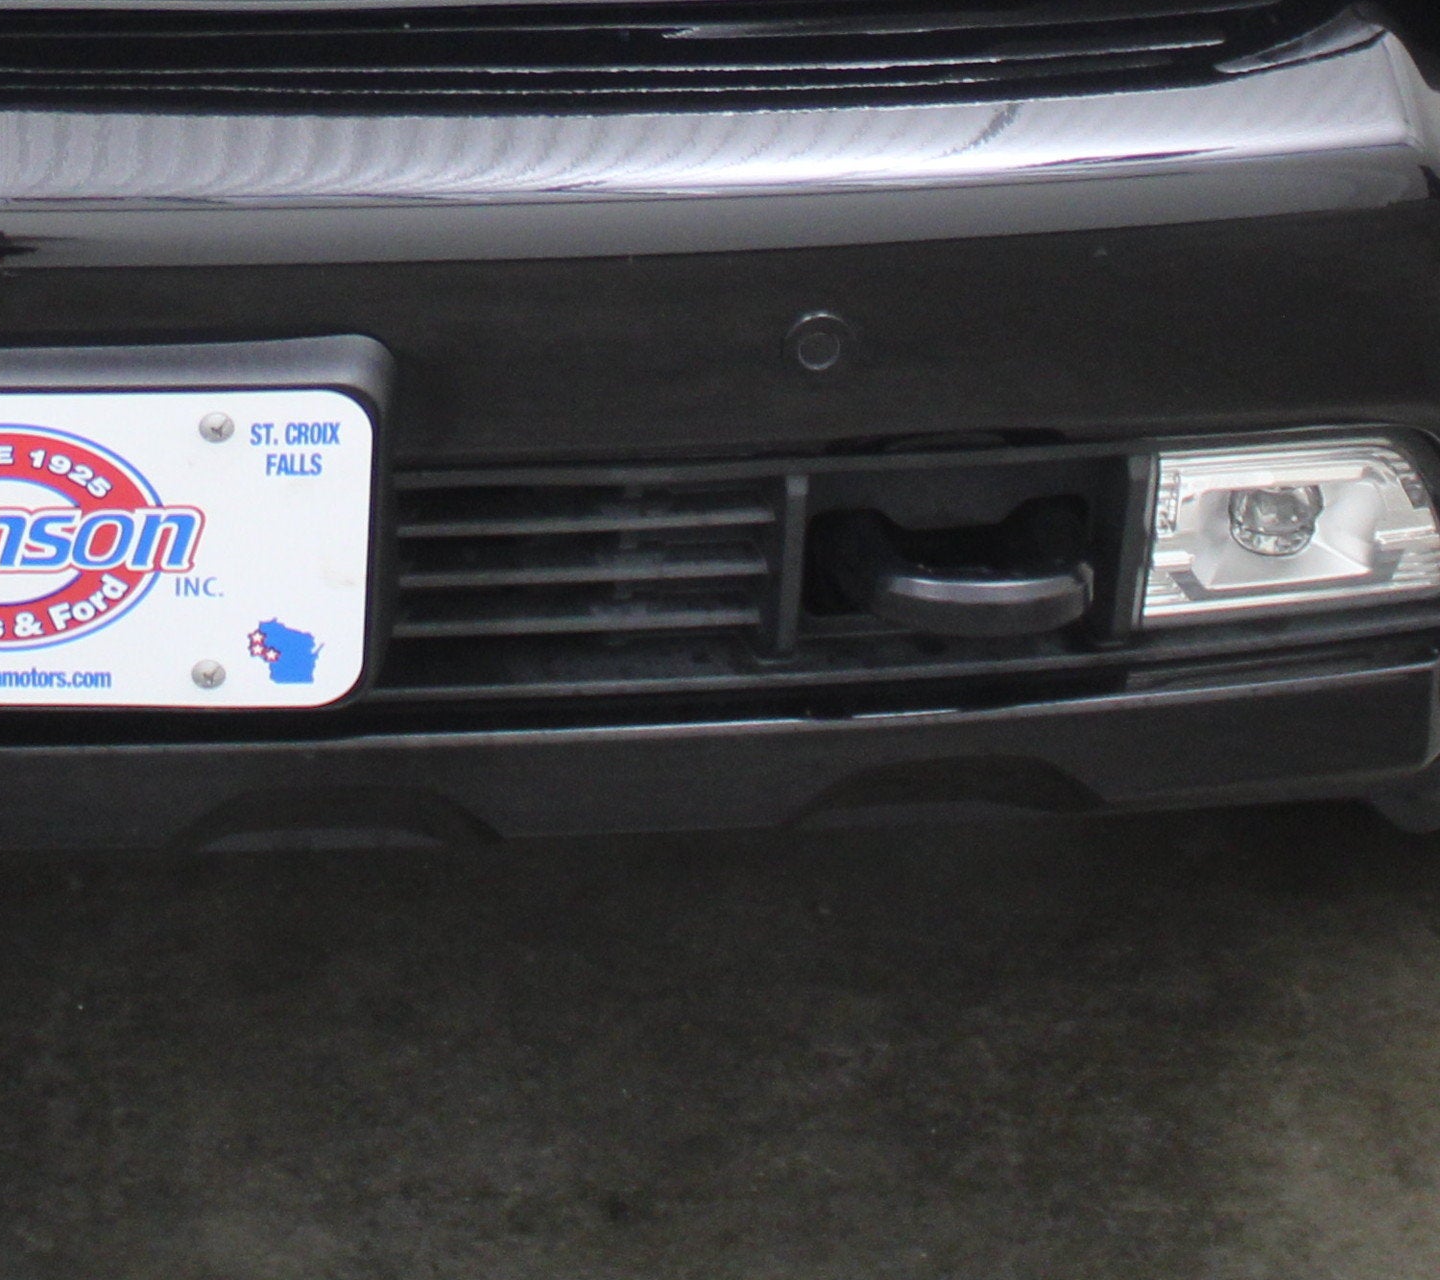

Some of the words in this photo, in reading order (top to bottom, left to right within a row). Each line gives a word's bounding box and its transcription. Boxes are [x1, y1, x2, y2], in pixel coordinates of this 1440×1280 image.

[250, 423, 278, 447] ST.
[285, 422, 341, 446] CROIX
[29, 449, 113, 499] 1925
[265, 453, 323, 477] FALLS
[175, 577, 225, 598] INC.
[13, 613, 45, 637] &
[47, 573, 129, 632] Ford
